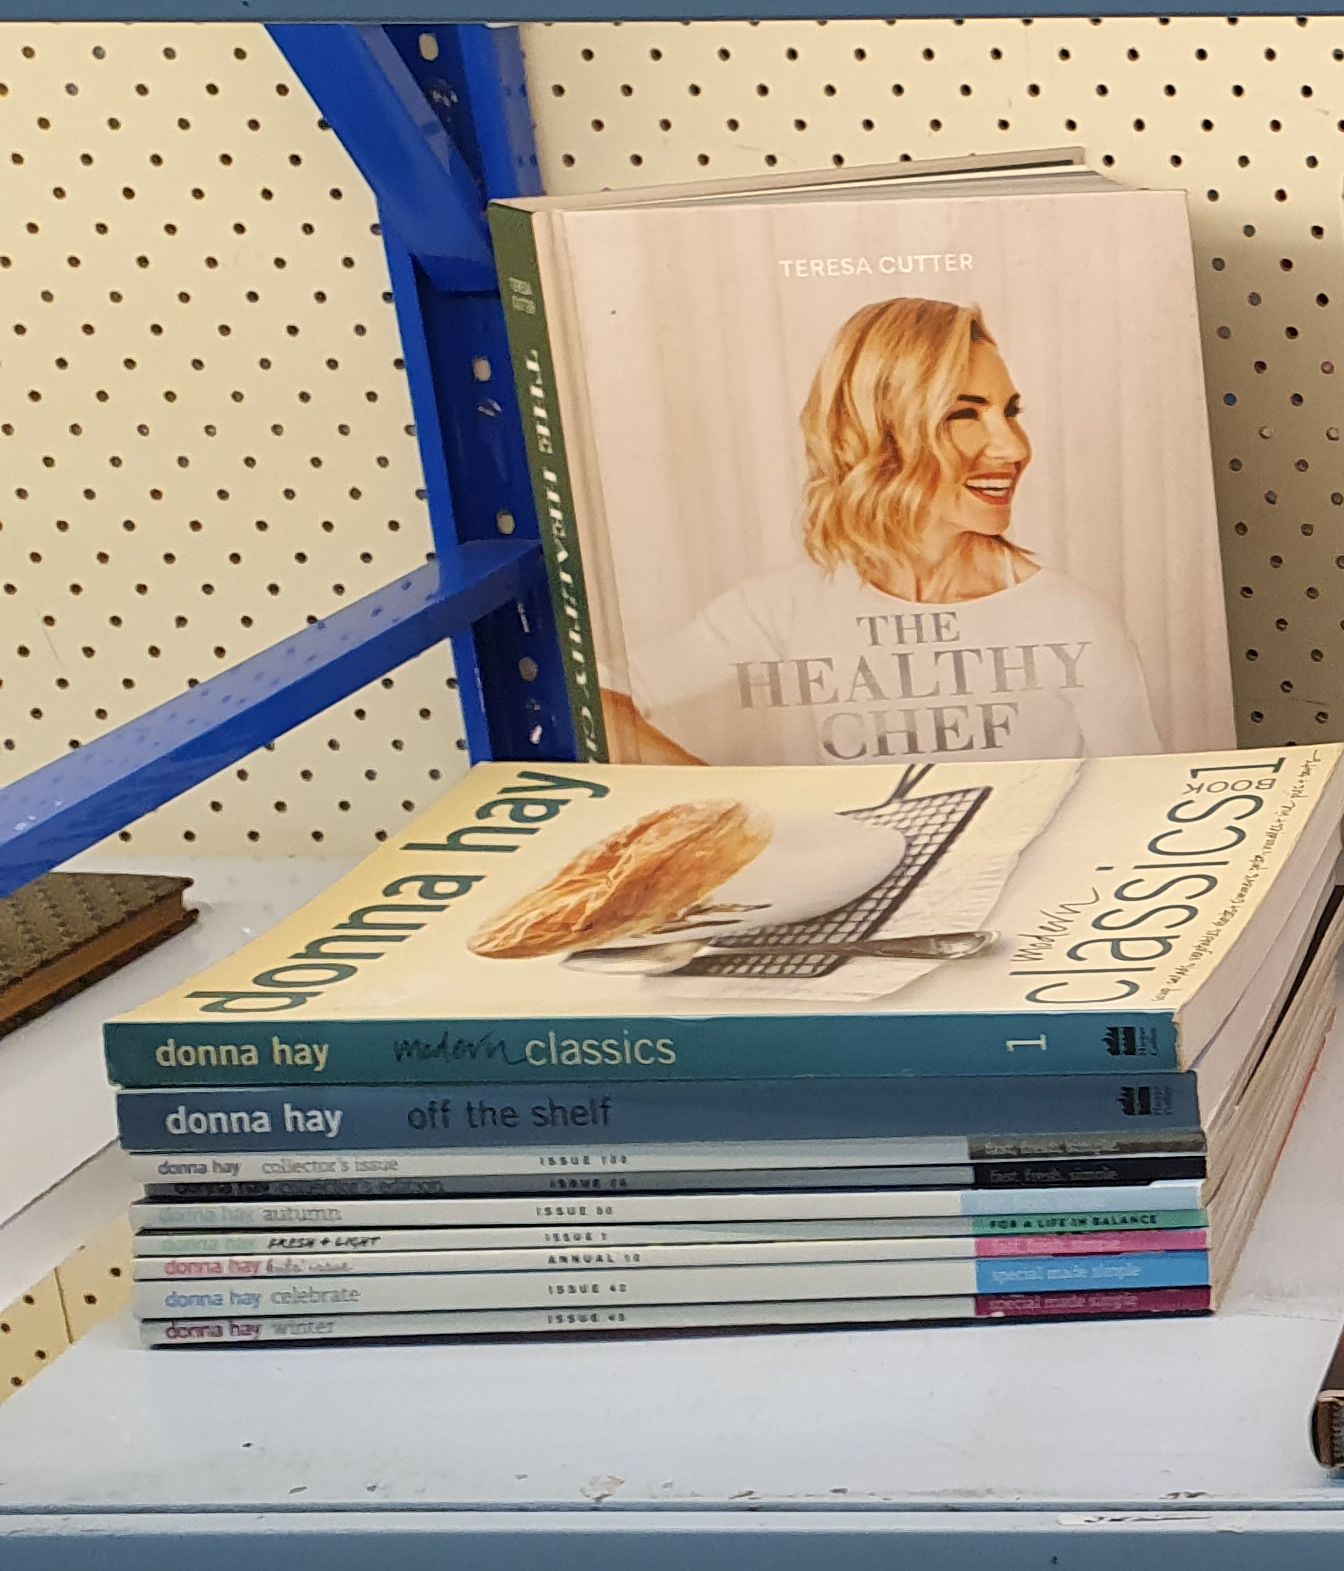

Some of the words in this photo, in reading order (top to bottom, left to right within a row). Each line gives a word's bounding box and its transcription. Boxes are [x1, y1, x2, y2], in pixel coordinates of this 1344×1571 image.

[778, 257, 873, 279] TERESA
[879, 253, 974, 274] CUTTER
[856, 611, 961, 647] THE
[729, 641, 1093, 710] HEALTHY
[820, 702, 1020, 760] CHEF
[1182, 777, 1277, 796] BOOK
[183, 873, 485, 1014] donna
[400, 770, 612, 855] hay
[1008, 794, 1264, 1004] classics
[155, 1038, 258, 1068] donna
[272, 1036, 329, 1071] hay
[525, 1030, 677, 1068] classics
[1006, 1034, 1048, 1052] 1
[165, 1104, 270, 1135] donna
[283, 1102, 343, 1137] hay
[407, 1100, 451, 1131] off
[466, 1100, 519, 1128] the
[532, 1097, 613, 1129] shelf
[158, 1160, 208, 1175] donna
[212, 1159, 241, 1176] hay
[355, 1156, 398, 1172] issue
[540, 1155, 591, 1166] ISSUE
[262, 1207, 342, 1222] autumn
[536, 1206, 587, 1216] ISSUE
[990, 1219, 1017, 1230] FOR
[1023, 1219, 1032, 1229] A
[1037, 1217, 1065, 1229] LIFE
[1071, 1217, 1088, 1228] IN
[1092, 1214, 1157, 1227] BALANCE
[545, 1232, 592, 1242] ISSUE
[164, 1259, 224, 1275] donna
[228, 1258, 260, 1277] hay
[548, 1254, 615, 1265] ANNUAL
[165, 1290, 223, 1308] donna
[229, 1290, 261, 1310] hay
[270, 1286, 361, 1304] celebrate
[548, 1284, 600, 1295] ISSUE
[548, 1313, 599, 1325] ISSUE
[165, 1320, 224, 1339] donna
[229, 1319, 263, 1340] hay
[270, 1319, 335, 1335] winter
